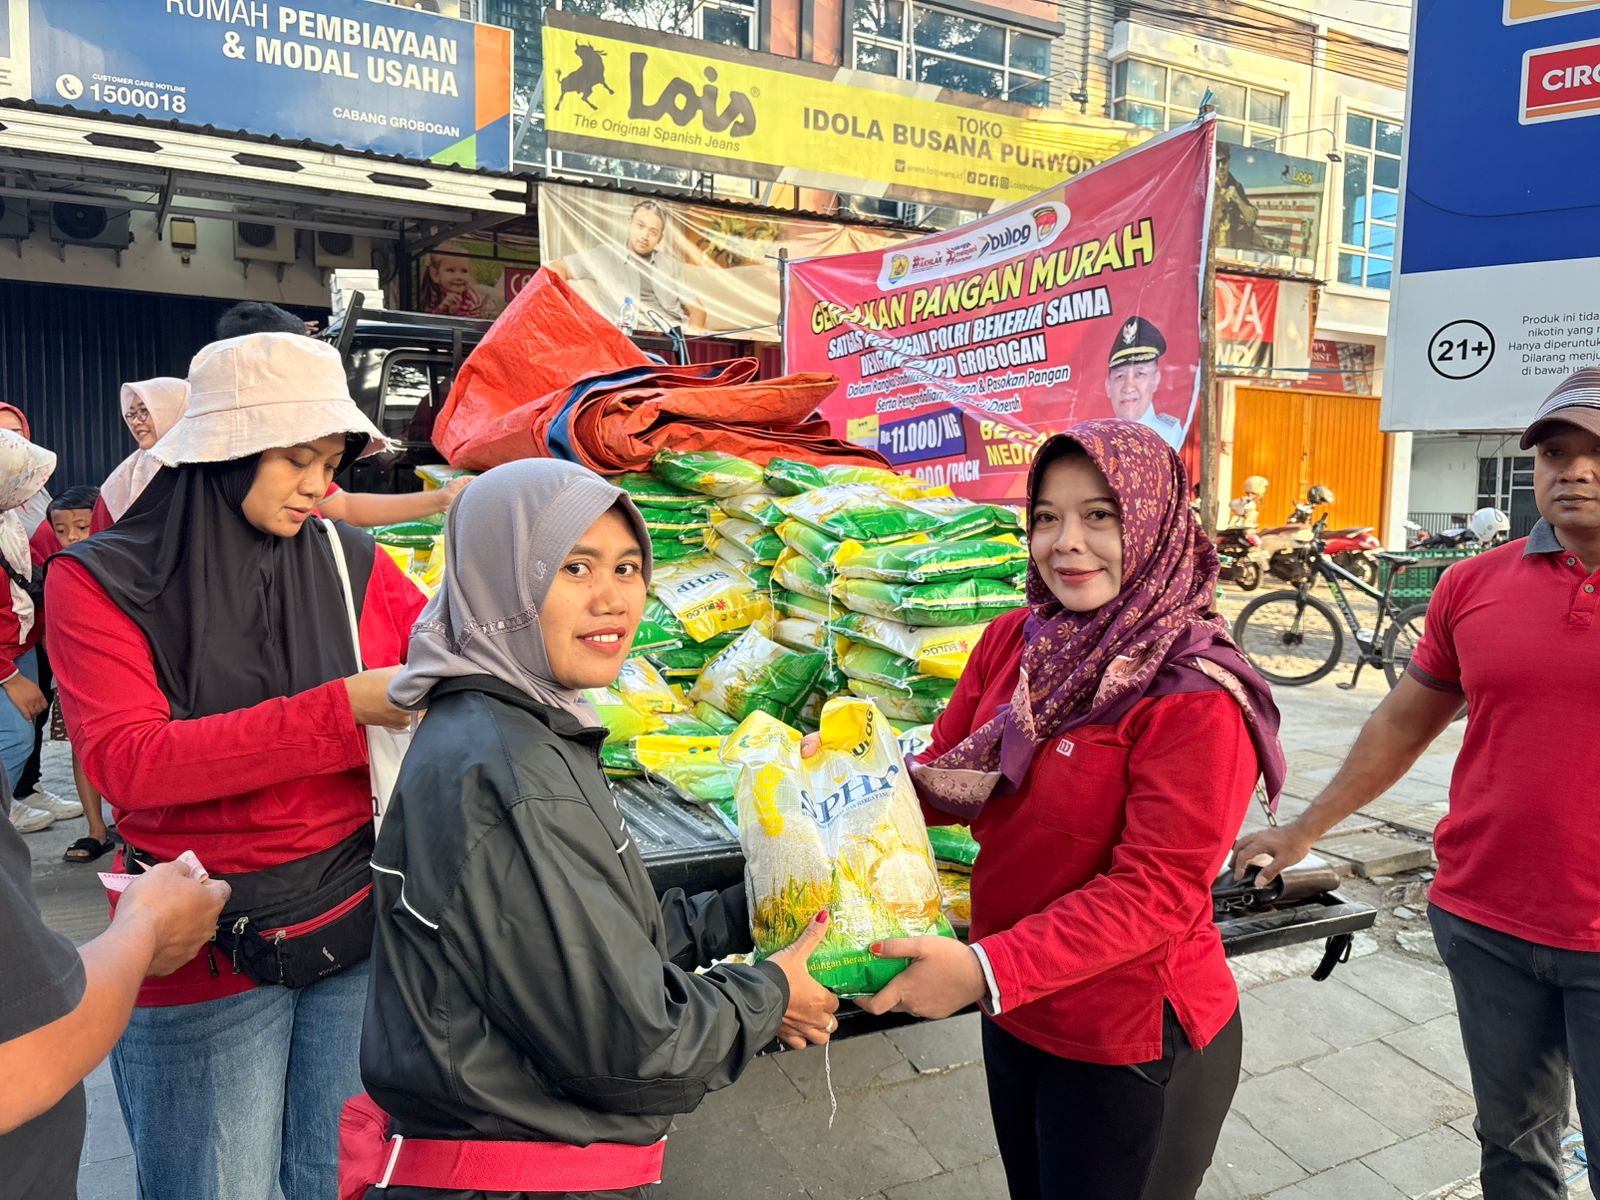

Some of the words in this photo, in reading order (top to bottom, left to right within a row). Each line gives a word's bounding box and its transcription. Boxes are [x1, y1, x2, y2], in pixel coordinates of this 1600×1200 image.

[278, 6, 457, 65] PEMBIAYAAN
[222, 31, 246, 60] &
[255, 36, 359, 79] MODAL
[367, 56, 458, 97] USAHA
[92, 73, 134, 86] CUSTOMER
[134, 79, 154, 88] CARE
[155, 81, 186, 93] HOTLINE
[628, 52, 756, 137] Lois
[90, 83, 187, 113] 1500018
[332, 107, 387, 126] CABANG
[389, 116, 460, 138] GROBOGAN
[574, 114, 598, 129] The
[601, 118, 650, 138] Original
[653, 127, 702, 145] Spanish
[705, 136, 740, 152] Jeans
[803, 107, 884, 142] IDOLA
[893, 123, 993, 160] BUSANA
[957, 116, 1001, 139] TOKO
[988, 225, 1031, 251] bulog
[911, 260, 1026, 323] PANGAN
[1028, 217, 1154, 296] MURAH
[929, 321, 972, 352] POLRI
[971, 302, 1045, 344] BEKERJA
[1045, 285, 1112, 327] SAMA
[1522, 313, 1560, 324] Produk
[1563, 312, 1576, 322] ini
[1528, 326, 1564, 337] nikotin
[1567, 326, 1593, 337] yang
[860, 350, 906, 377] DENGAN
[957, 332, 1047, 377] GROBOGAN
[1437, 336, 1489, 363] 21+
[1508, 341, 1541, 352] Hanya
[1522, 353, 1566, 363] Dilarang
[848, 384, 872, 396] Dalam
[979, 379, 985, 393] &
[987, 373, 1025, 391] Pasokan
[1028, 367, 1069, 385] Pangan
[1521, 366, 1531, 376] di
[1534, 365, 1569, 376] bawah
[877, 398, 897, 412] Serta
[988, 396, 1021, 412] Daerah
[677, 571, 730, 594] SPHP
[687, 600, 716, 619] BULOG
[922, 642, 958, 656] BULOG
[843, 955, 867, 966] Beras
